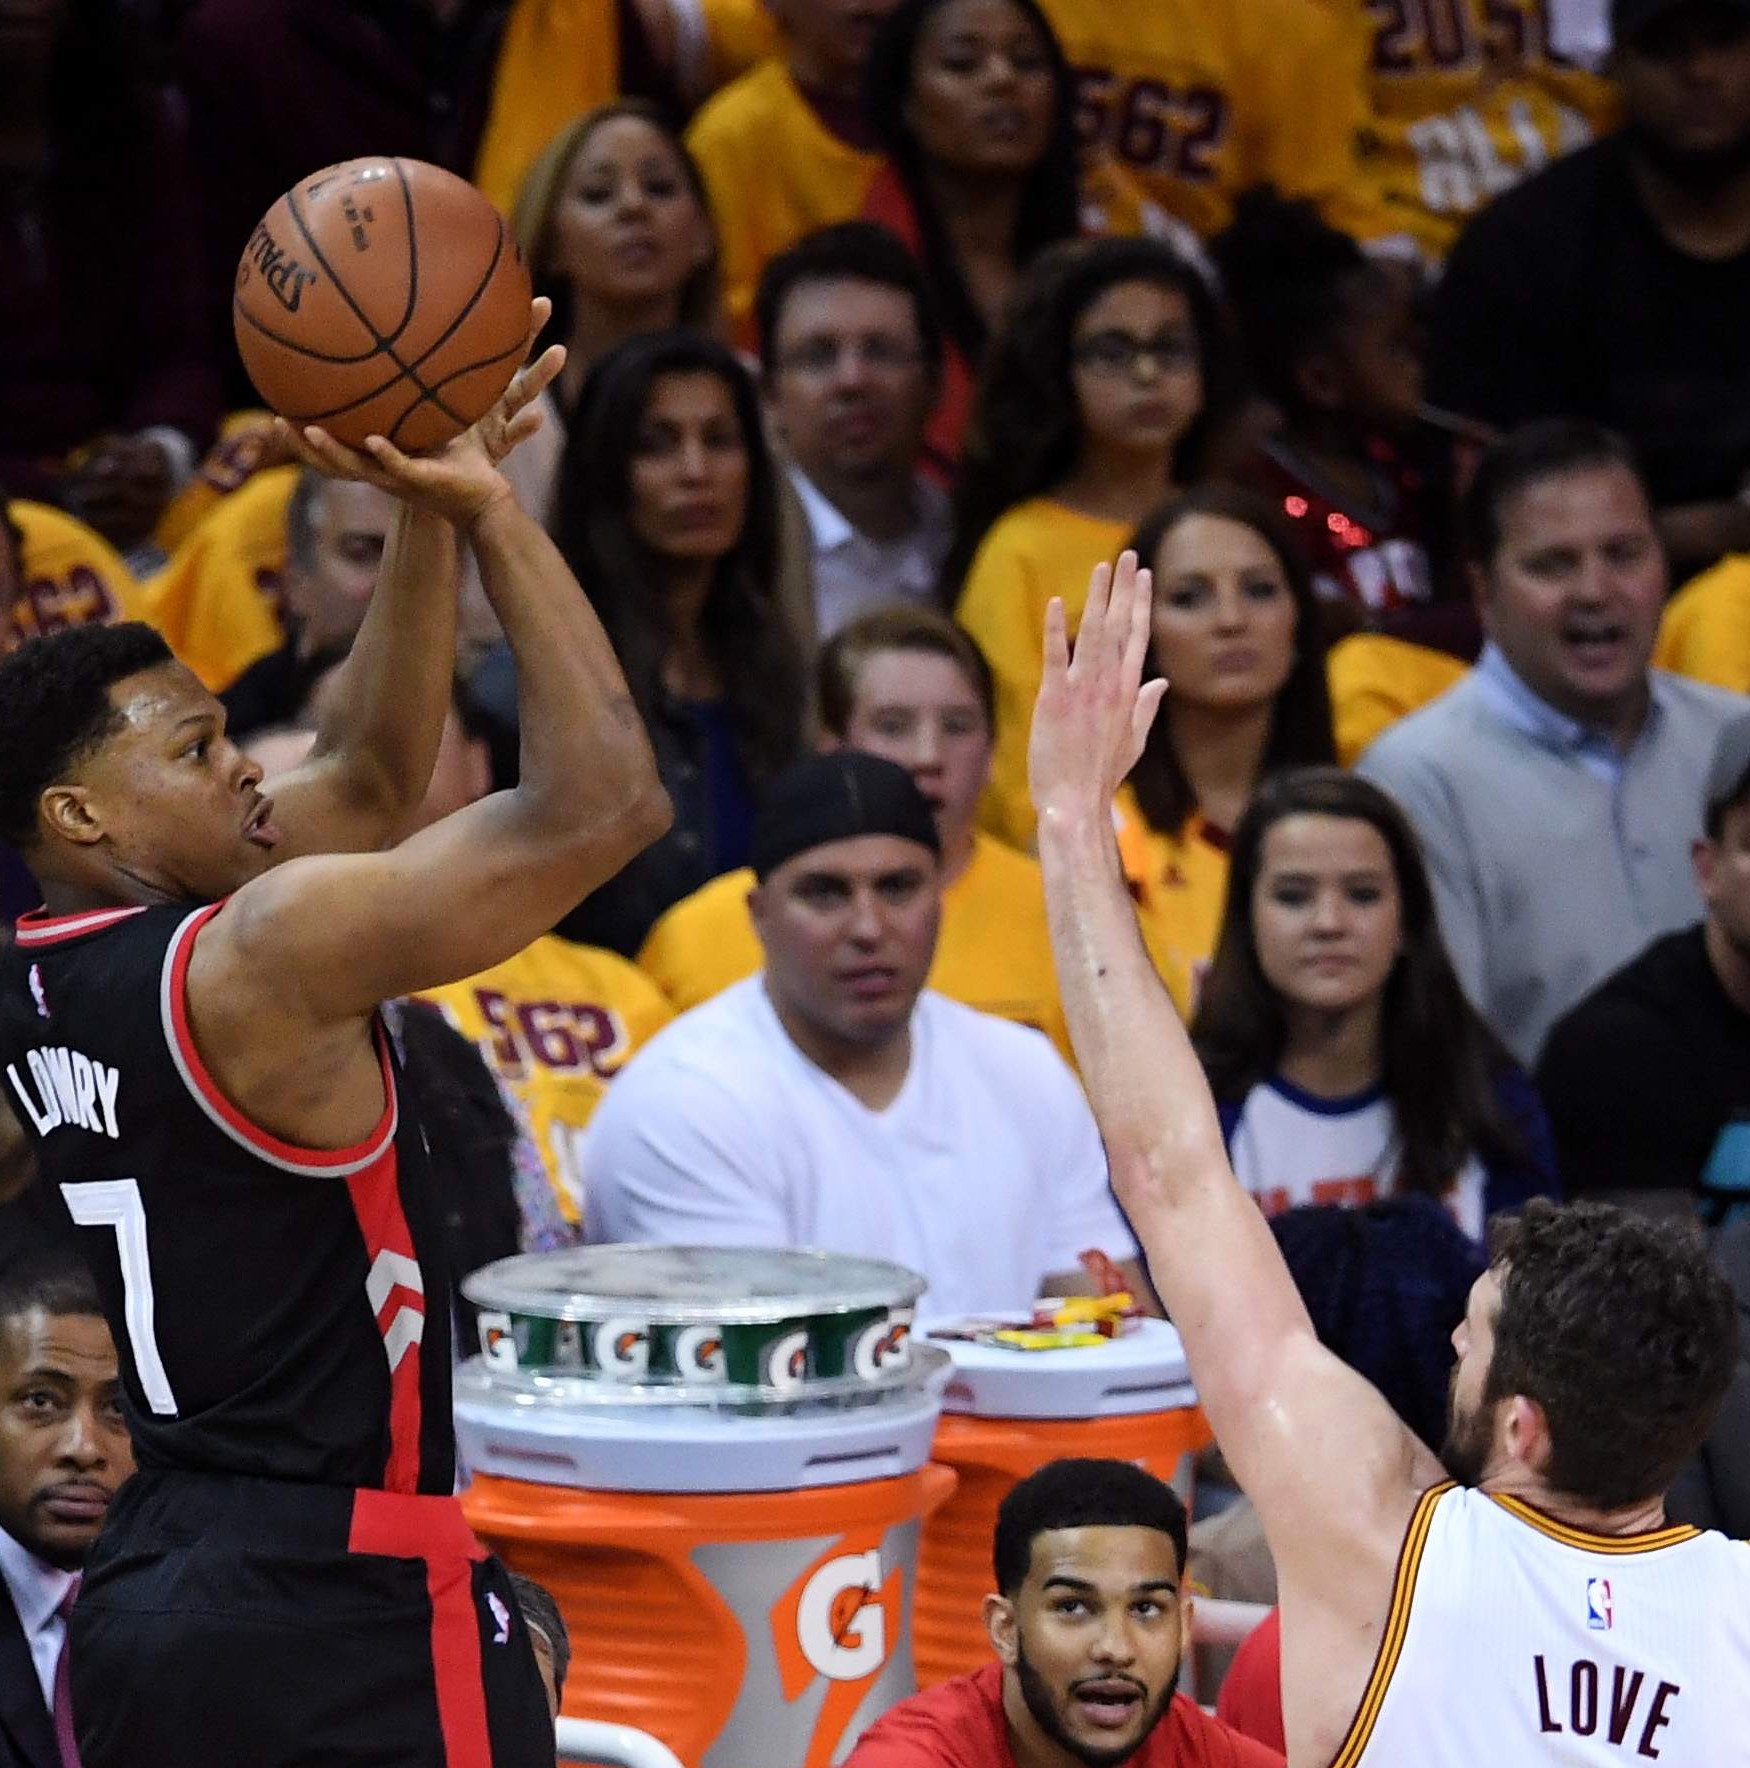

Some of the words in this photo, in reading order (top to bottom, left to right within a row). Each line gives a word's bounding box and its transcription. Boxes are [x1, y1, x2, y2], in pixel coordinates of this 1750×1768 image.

[6, 1045, 120, 1140] LOWRY
[59, 1178, 179, 1417] 7
[796, 1549, 886, 1682] G
[1533, 1654, 1681, 1761] LOVE
